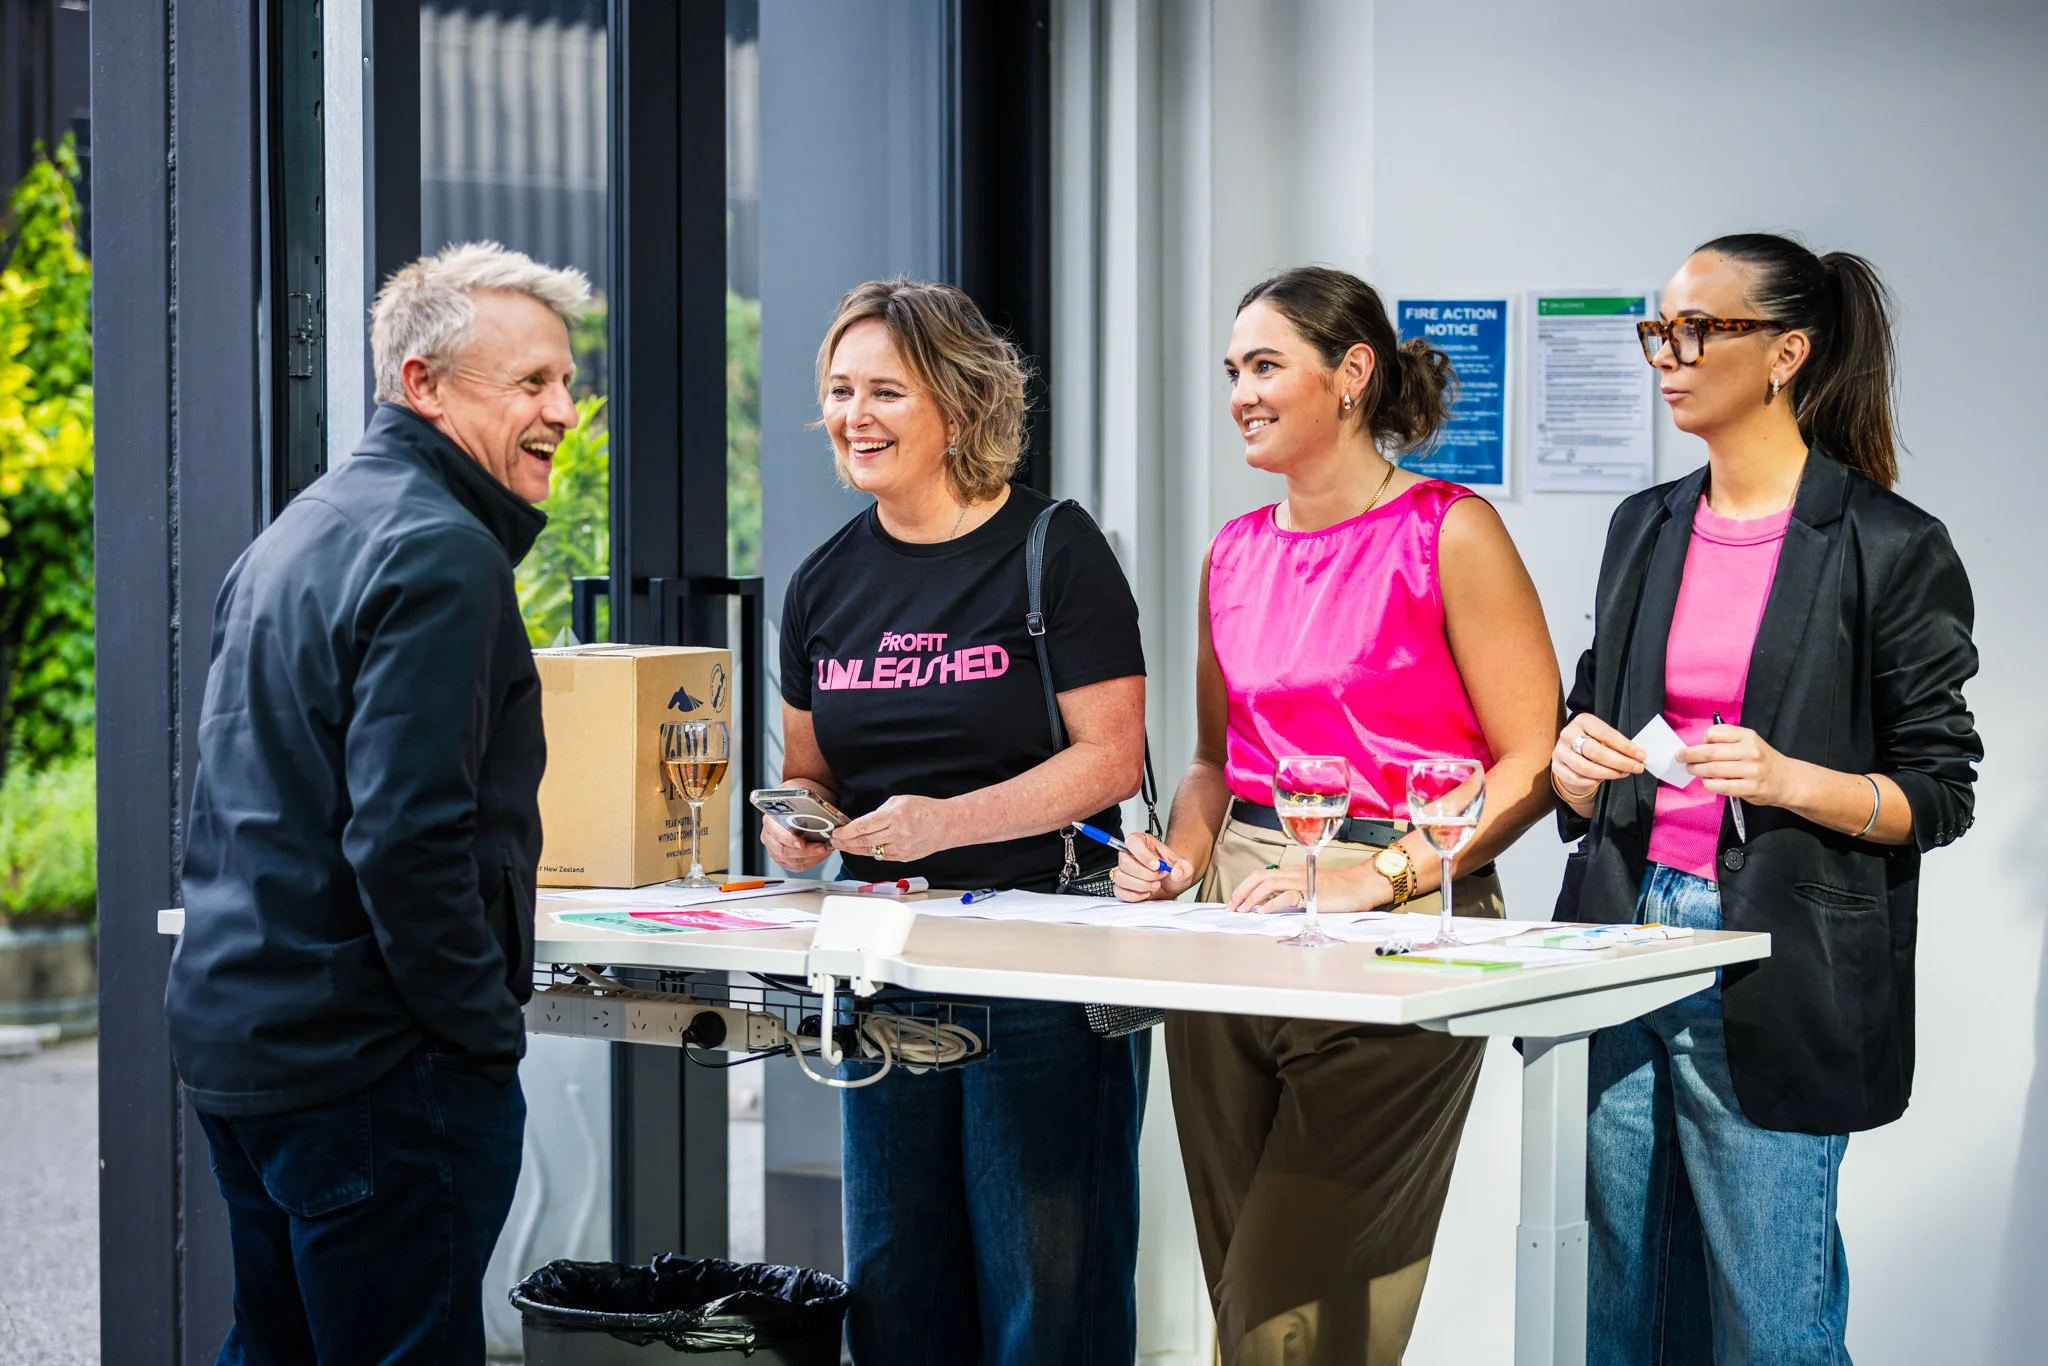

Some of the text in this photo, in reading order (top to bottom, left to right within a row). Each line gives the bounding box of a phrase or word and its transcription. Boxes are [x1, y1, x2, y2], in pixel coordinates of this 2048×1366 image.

[1405, 307, 1498, 320] FIRE ACTION
[1424, 323, 1478, 337] NOTICE
[878, 633, 948, 652] PROFIT
[818, 645, 1010, 691] UNLEASHED
[665, 818, 678, 828] PEAK
[658, 831, 679, 842] WITHOUT
